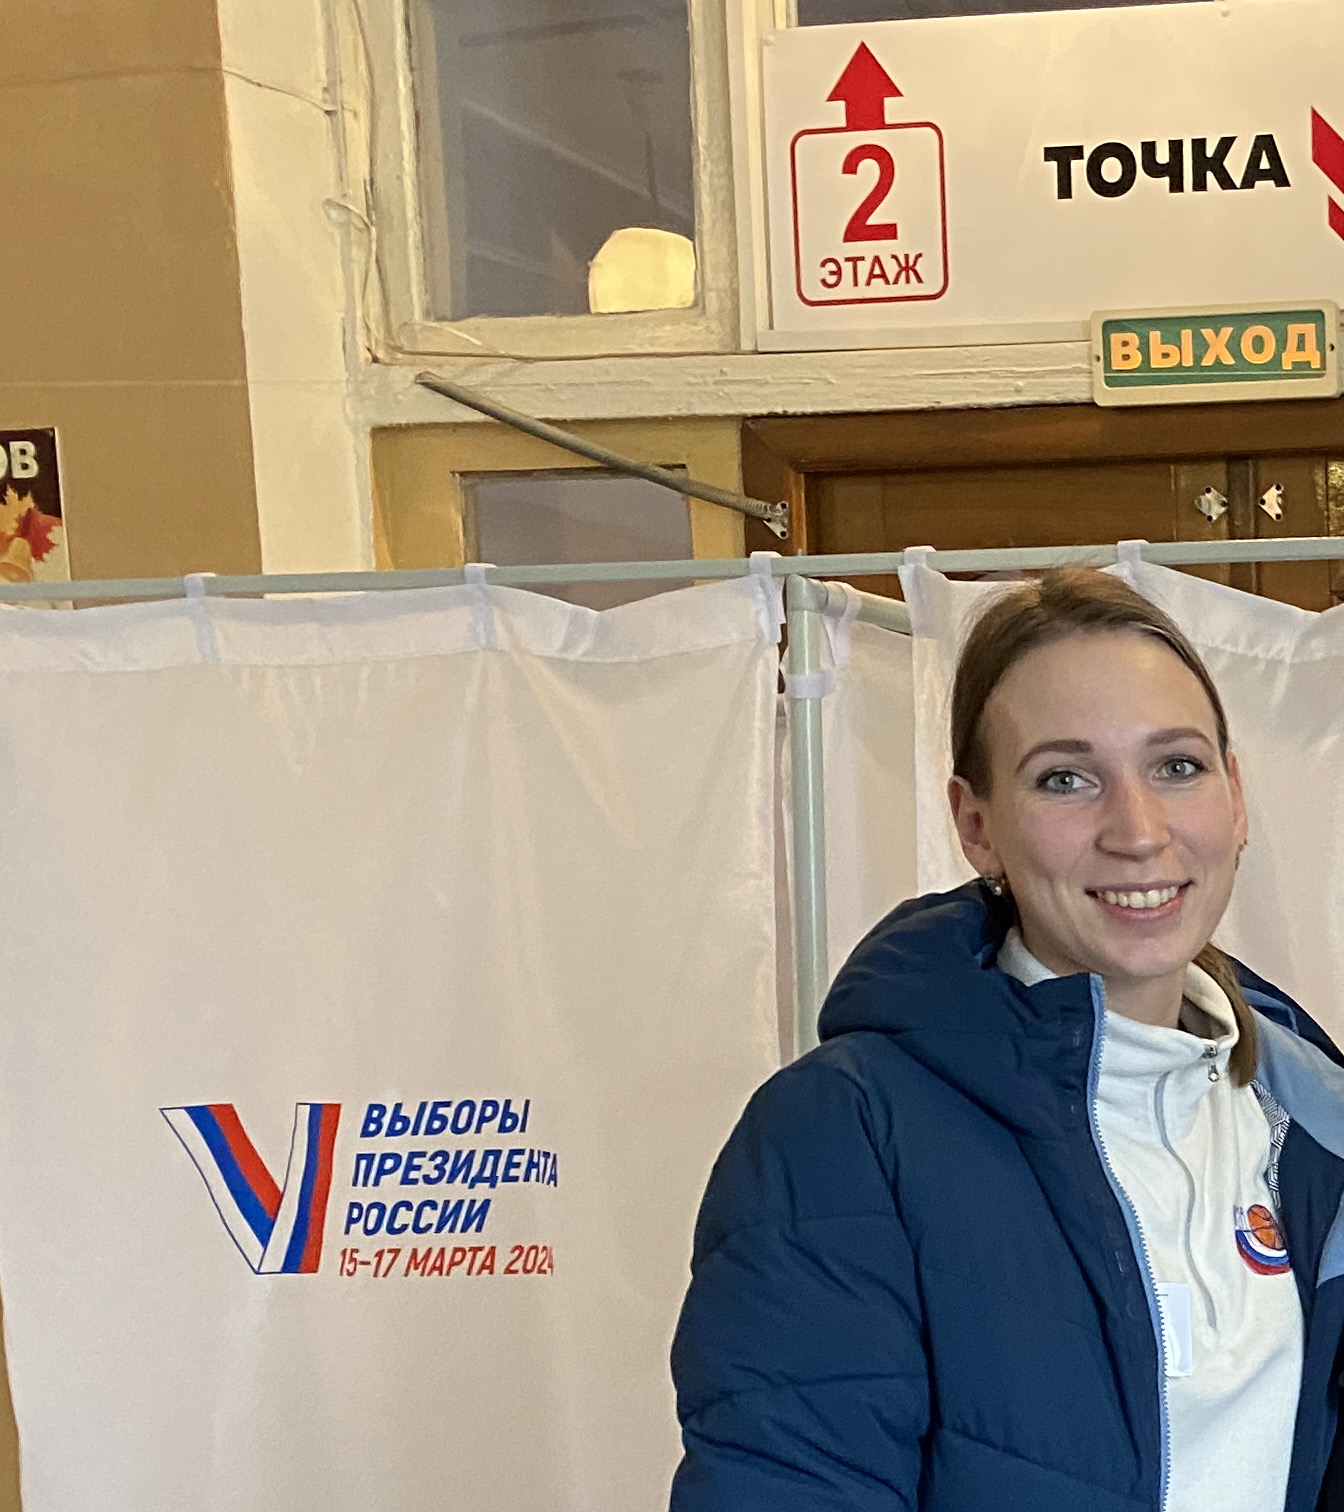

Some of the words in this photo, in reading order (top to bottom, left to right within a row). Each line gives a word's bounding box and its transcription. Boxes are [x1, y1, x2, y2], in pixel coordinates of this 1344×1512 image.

[1043, 134, 1292, 201] ТОЧКА
[840, 143, 900, 244] 2
[818, 252, 925, 291] ЭТАЖ
[1109, 320, 1322, 373] ВЫХОД
[0, 440, 39, 480] В
[360, 1098, 531, 1138] ВЫБОРЫ
[351, 1148, 559, 1189] ПРЕЗИДЕНТА
[344, 1198, 491, 1236] РОССИИ
[403, 1246, 497, 1278] МАРТА
